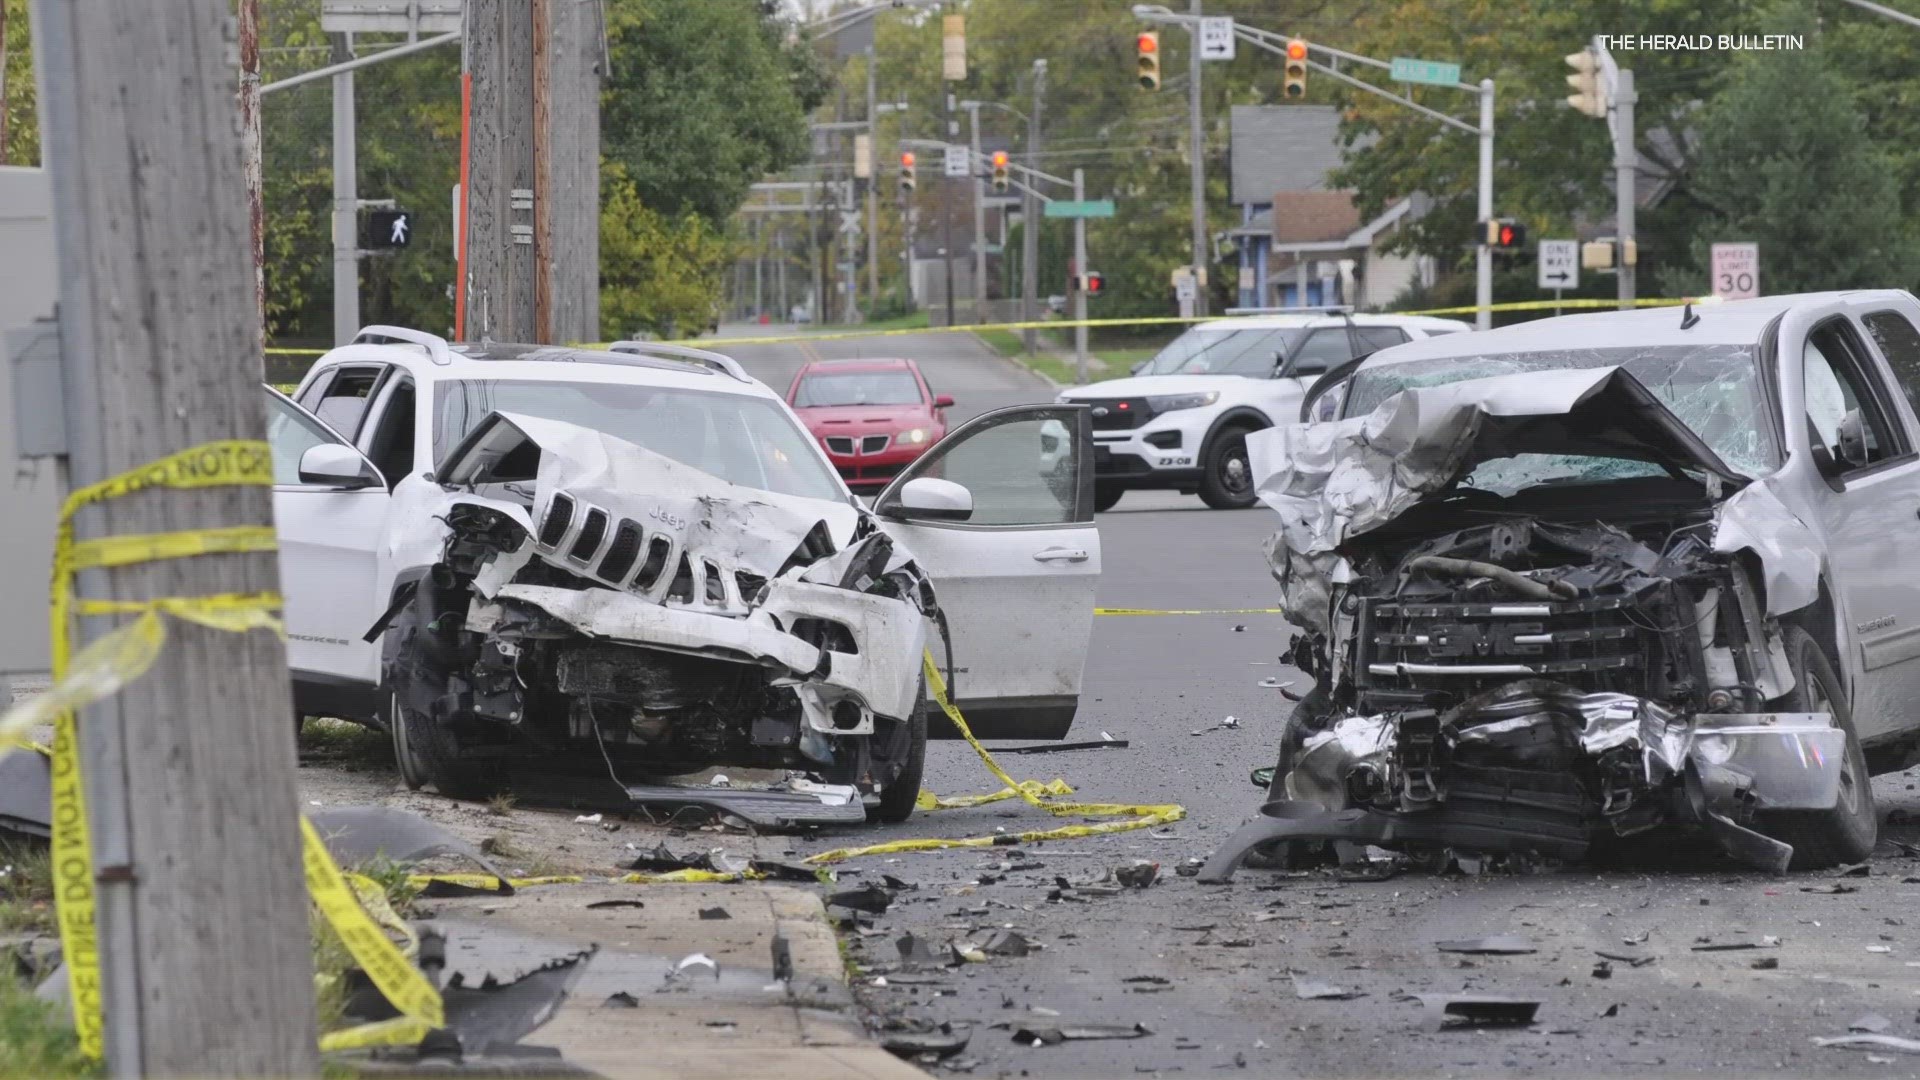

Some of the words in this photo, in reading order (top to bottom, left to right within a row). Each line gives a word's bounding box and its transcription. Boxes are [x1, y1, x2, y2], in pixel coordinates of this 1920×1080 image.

[1547, 244, 1570, 254] ONE
[1717, 250, 1755, 259] SPEED
[1547, 257, 1572, 267] WAY
[1720, 272, 1753, 293] 30
[175, 448, 231, 480] NOT
[649, 505, 686, 531] Jeep
[1428, 622, 1544, 657] GMC
